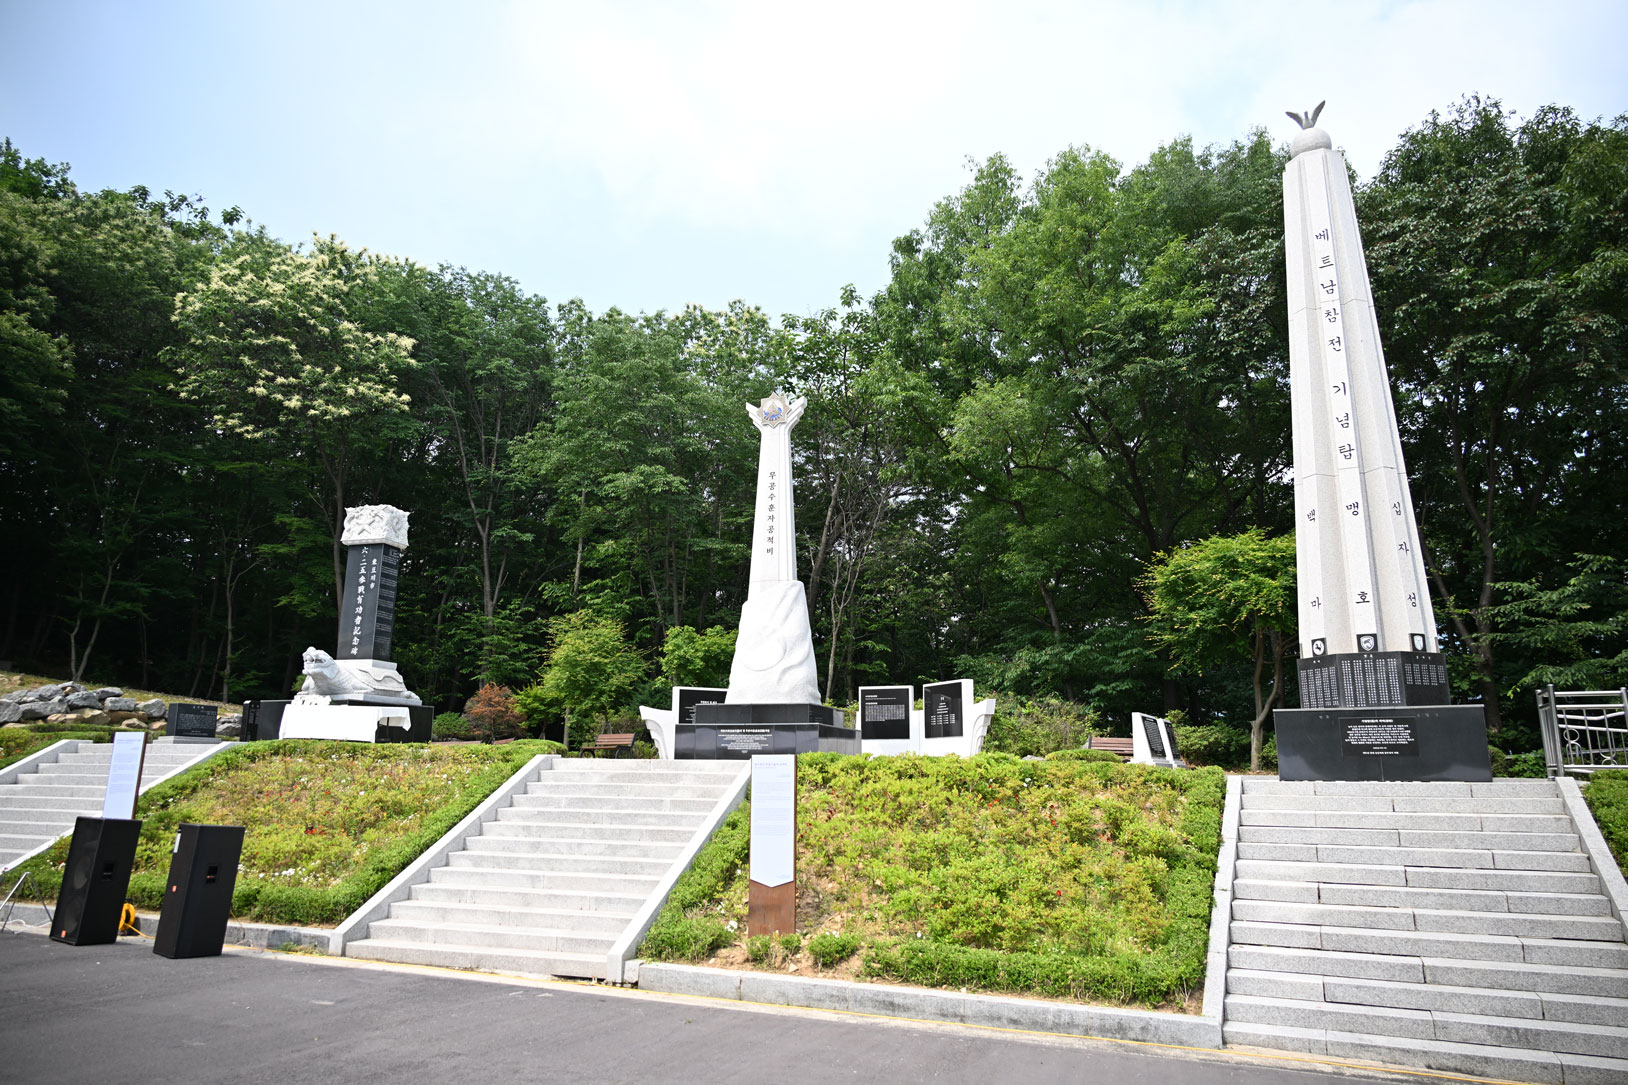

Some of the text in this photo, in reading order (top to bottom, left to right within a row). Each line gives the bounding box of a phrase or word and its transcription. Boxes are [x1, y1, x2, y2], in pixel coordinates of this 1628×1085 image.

[1315, 228, 1355, 460] 베트남참전 기념탑
[767, 472, 776, 555] 무공수훈자공적비
[1306, 508, 1321, 610] 백마
[1345, 501, 1370, 605] 맹호
